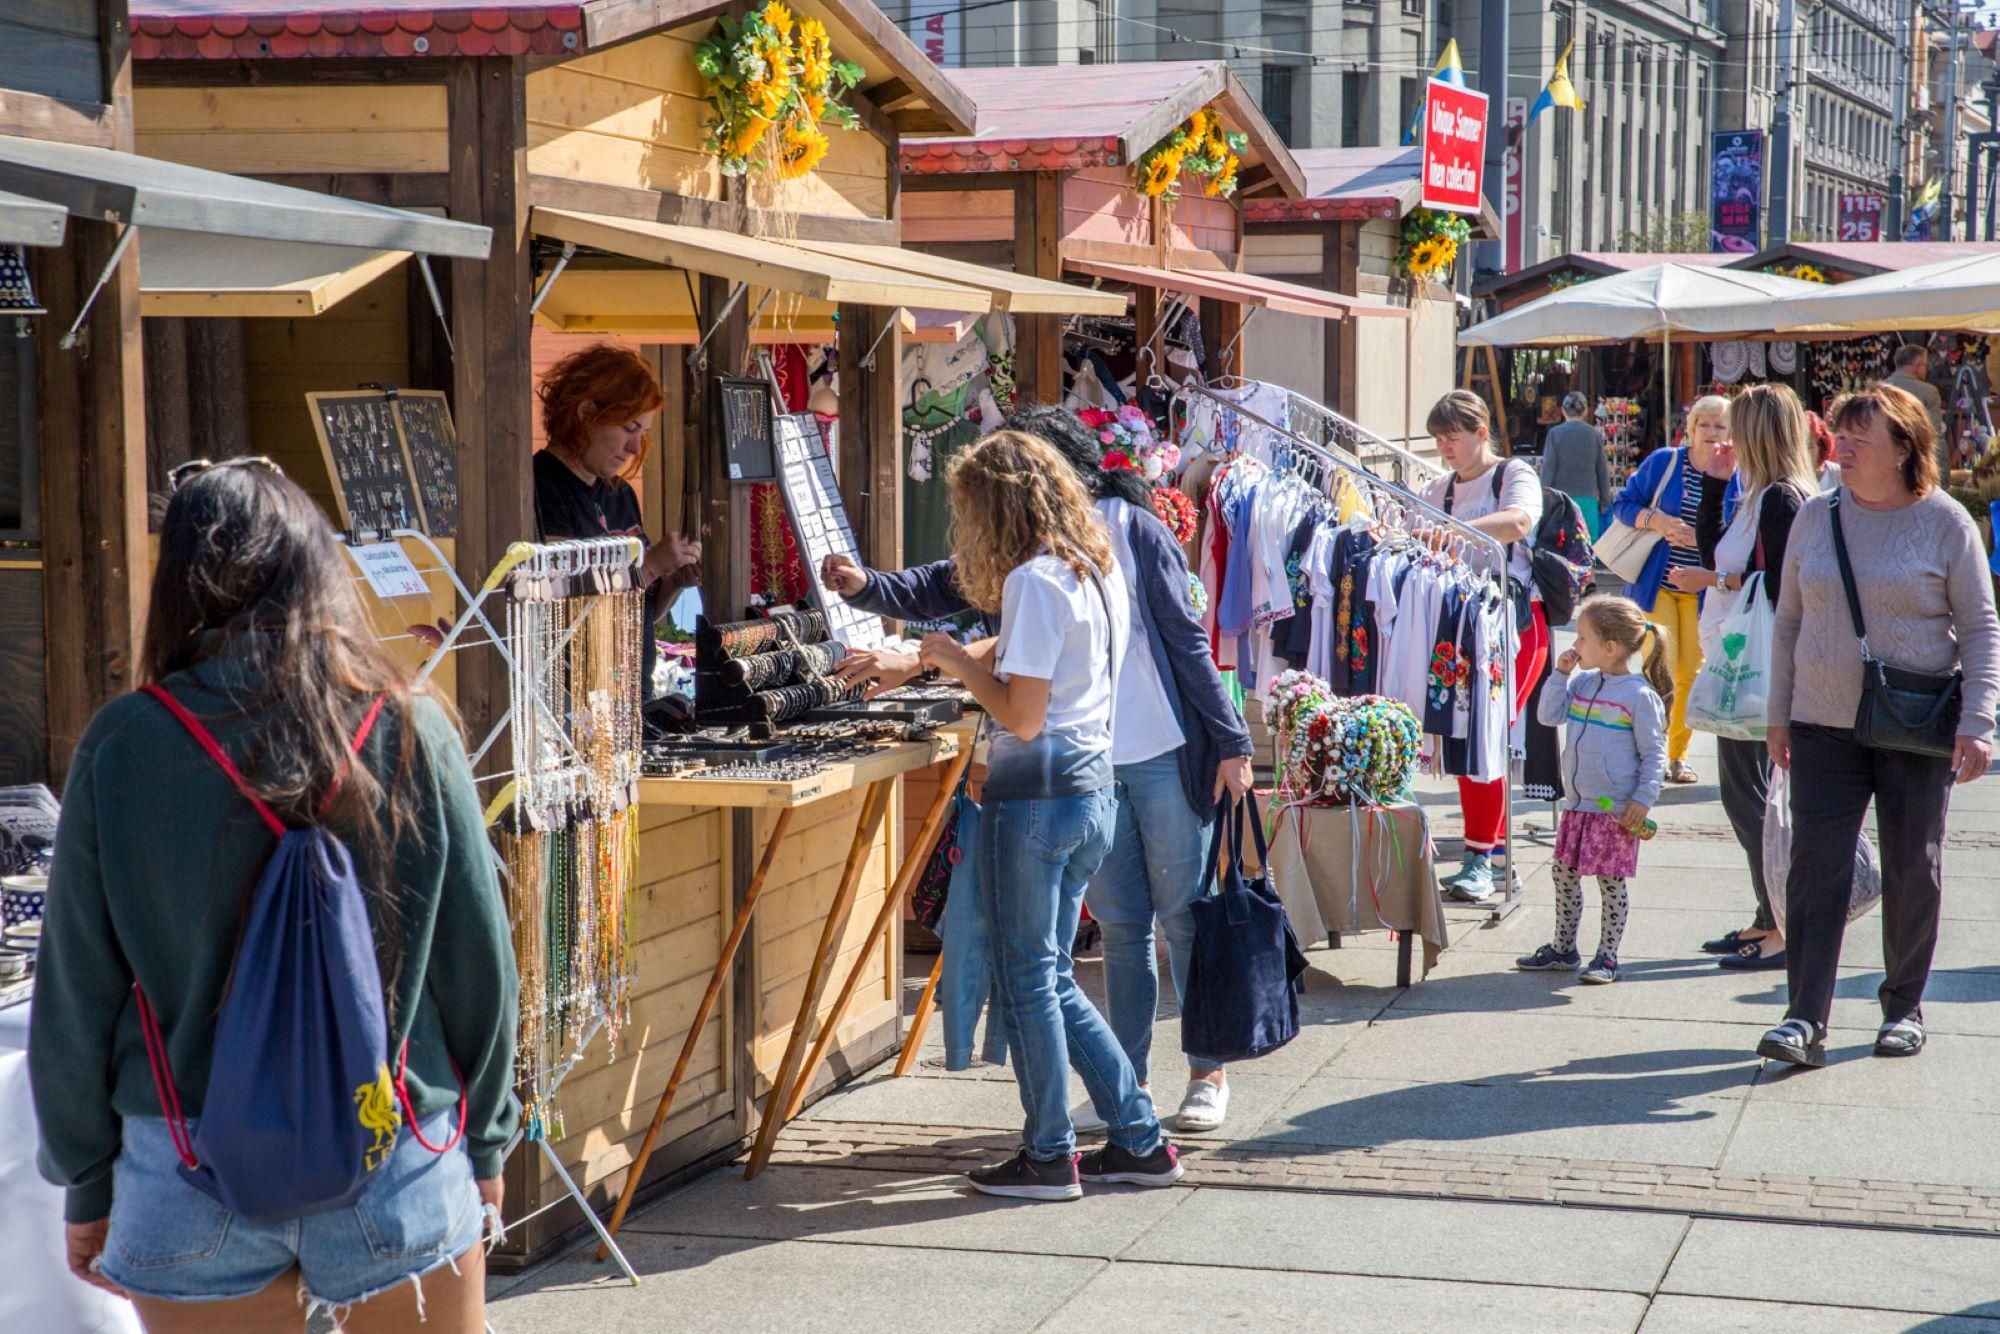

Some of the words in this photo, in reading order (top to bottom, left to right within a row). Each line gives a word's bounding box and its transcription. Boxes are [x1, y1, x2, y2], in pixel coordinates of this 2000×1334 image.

[1431, 99, 1455, 145] Unique
[1455, 106, 1482, 142] Summer
[1446, 156, 1477, 194] collection
[1843, 195, 1881, 215] 115
[1840, 221, 1872, 241] 25
